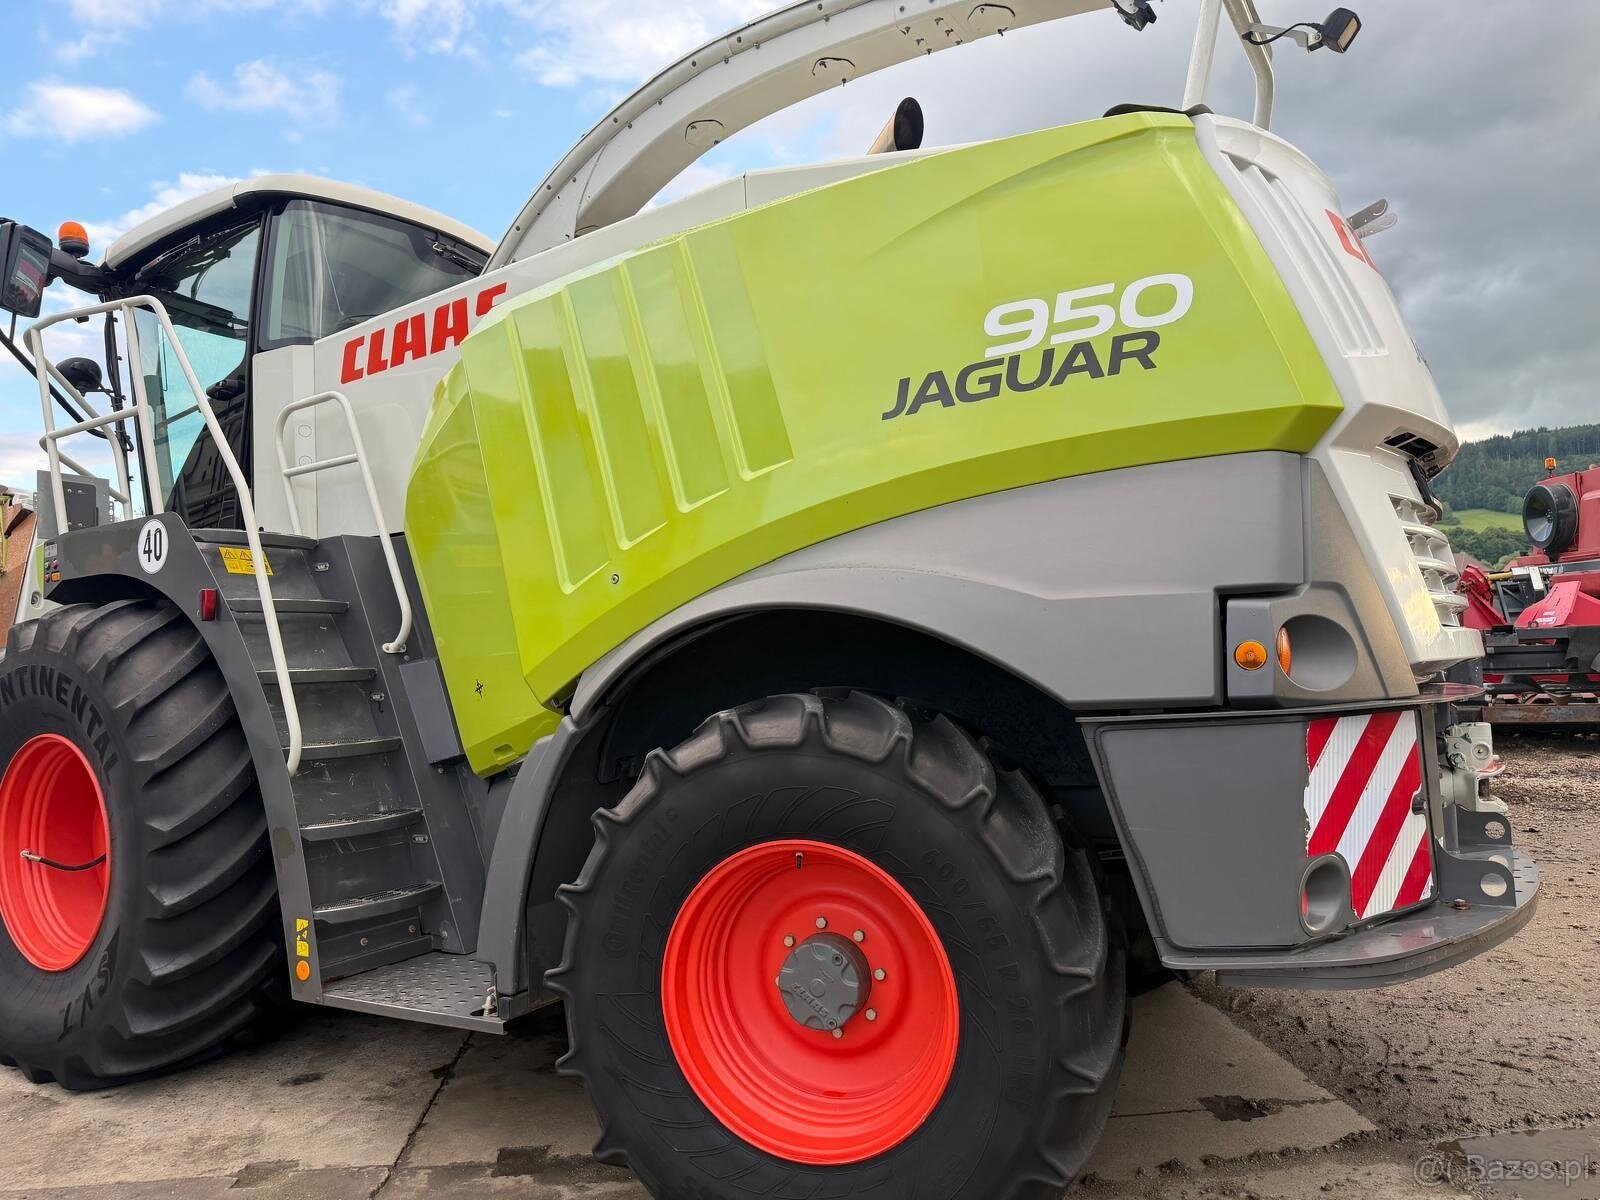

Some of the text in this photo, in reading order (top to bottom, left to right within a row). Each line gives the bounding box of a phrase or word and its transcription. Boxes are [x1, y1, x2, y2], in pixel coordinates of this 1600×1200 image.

[983, 273, 1194, 358] 950
[881, 330, 1161, 421] JAGUAR
[143, 527, 162, 563] 40
[0, 664, 119, 787] NTINENTAL
